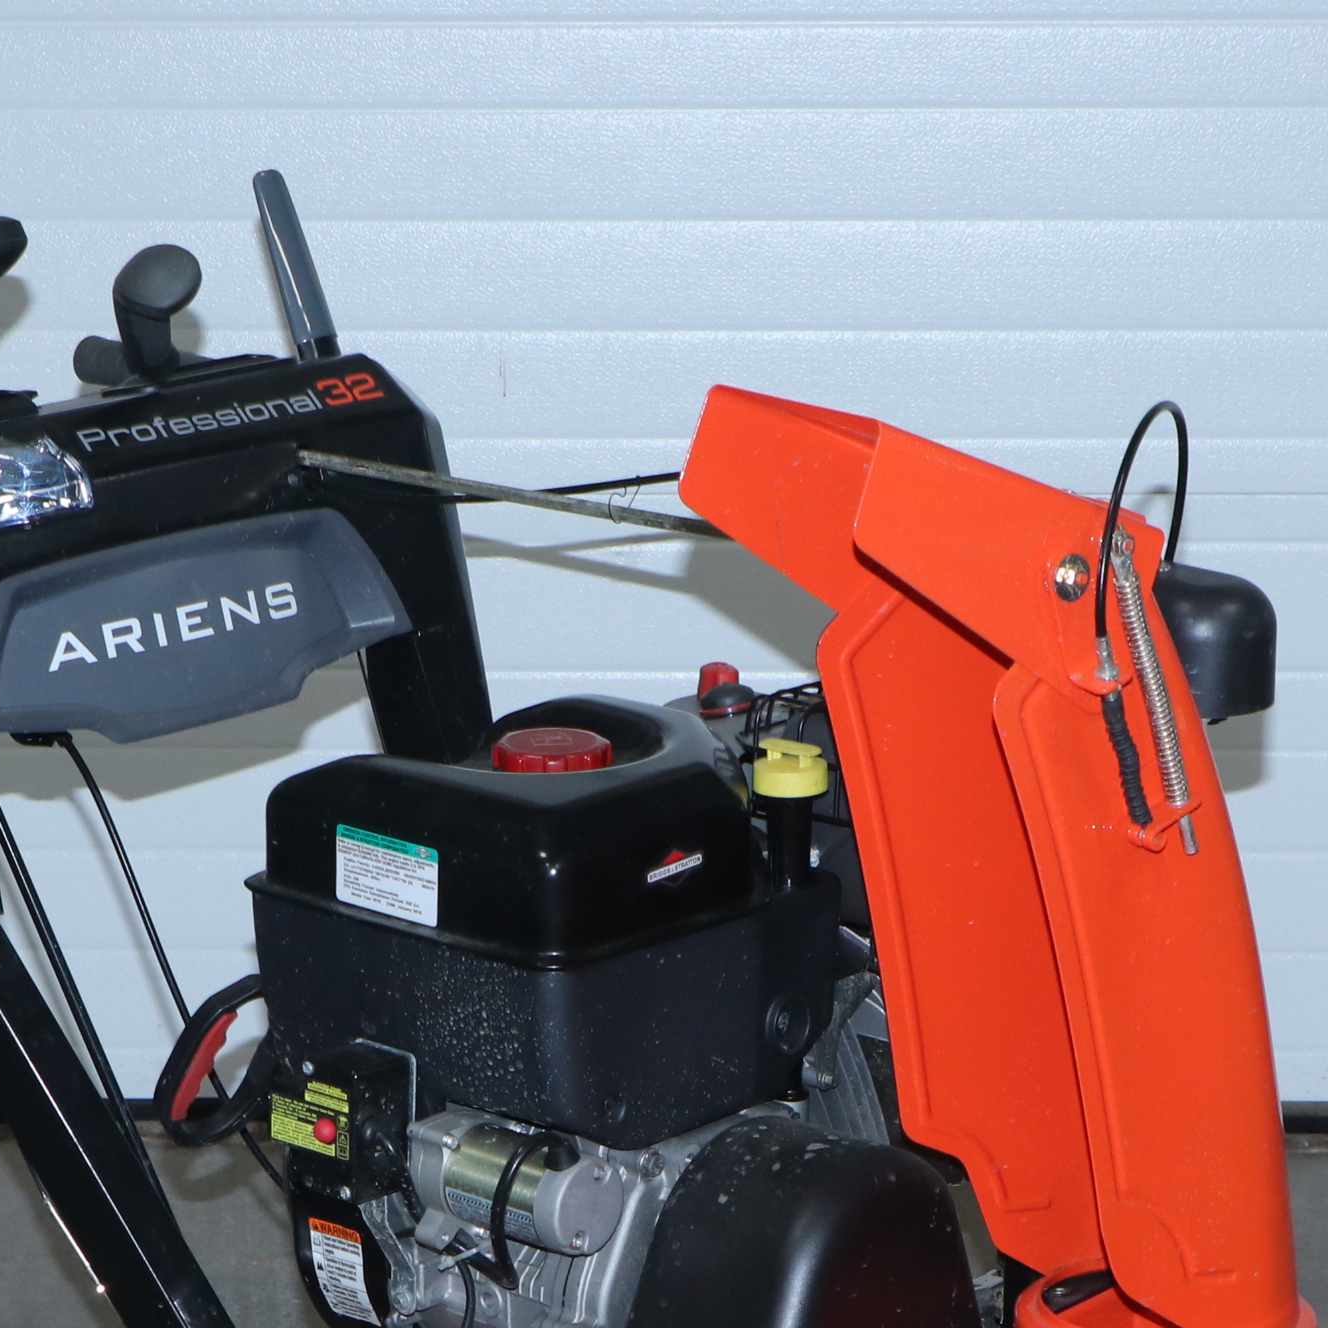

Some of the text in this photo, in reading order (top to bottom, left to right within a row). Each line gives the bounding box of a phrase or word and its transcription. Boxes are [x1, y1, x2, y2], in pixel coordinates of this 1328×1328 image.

[76, 372, 385, 452] Professional 32
[48, 581, 298, 673] ARIENS
[649, 867, 671, 881] BRIGGS
[675, 856, 701, 871] STRATTON
[320, 1221, 358, 1241] WARNING
